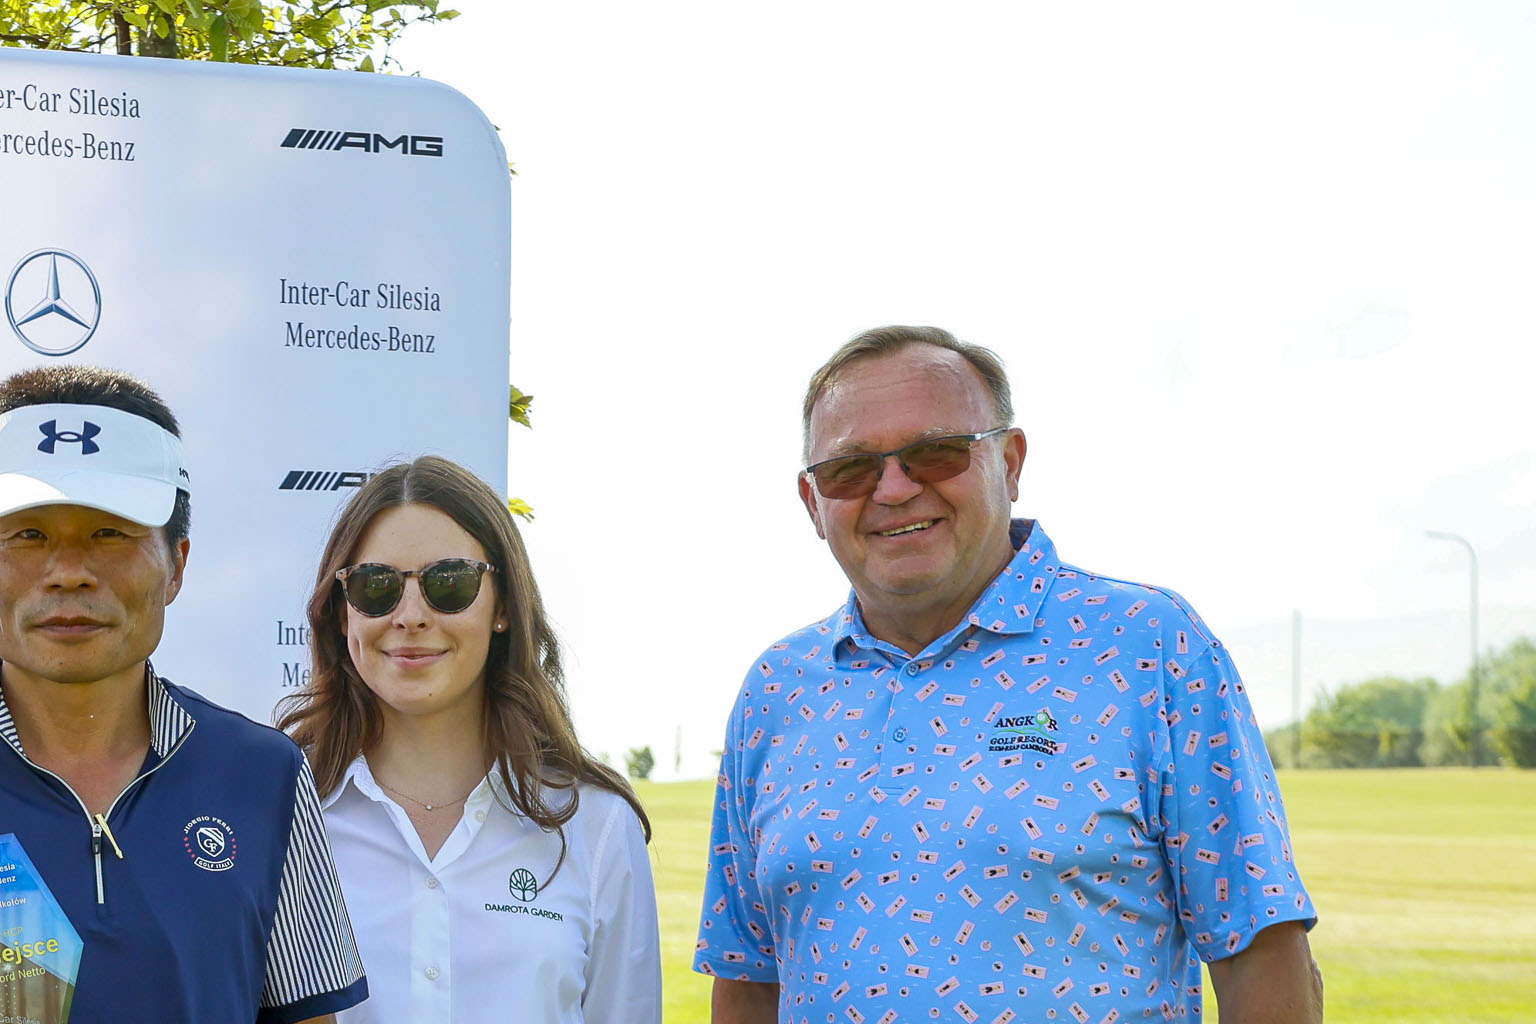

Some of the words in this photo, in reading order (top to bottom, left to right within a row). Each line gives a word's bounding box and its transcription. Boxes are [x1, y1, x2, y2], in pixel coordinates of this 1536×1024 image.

[68, 87, 142, 119] Silesia
[334, 133, 443, 157] AMG
[279, 277, 372, 308] Inter-Car
[375, 282, 442, 313] Silesia
[283, 321, 436, 354] Mercedes-Benz
[485, 904, 529, 914] DAMROTA
[531, 908, 563, 921] GARDEN
[19, 966, 46, 978] Netto
